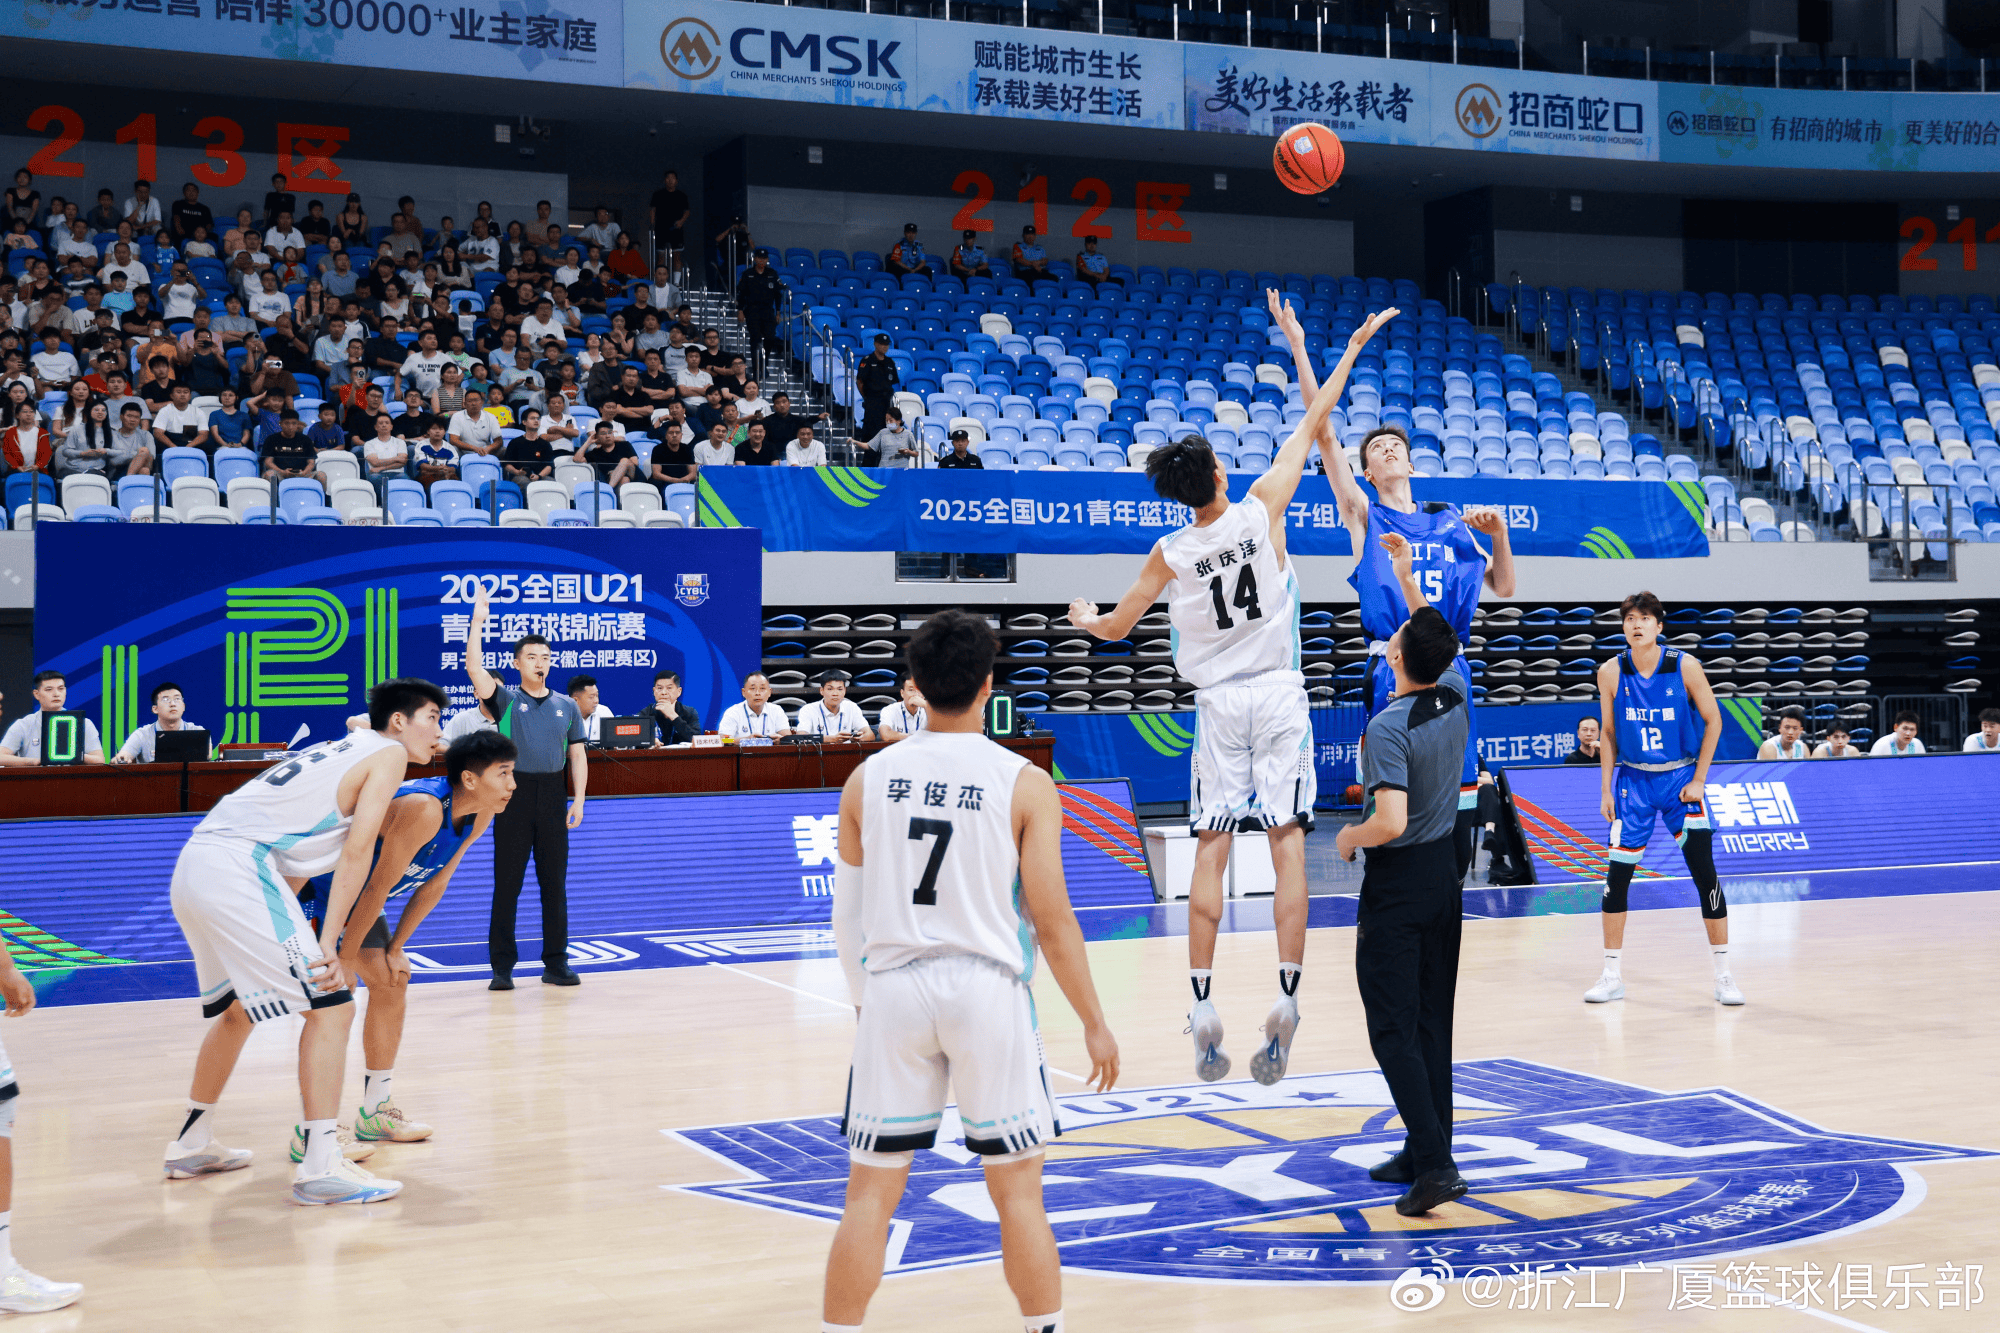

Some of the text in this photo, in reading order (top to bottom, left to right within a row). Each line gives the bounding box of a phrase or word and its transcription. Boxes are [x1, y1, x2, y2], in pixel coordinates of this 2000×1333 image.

[729, 27, 902, 79] CMSK
[974, 40, 1142, 81] 赋能城市生长
[730, 70, 903, 92] CHINA MERCHANTS SHEKOU HOLDINGS
[974, 76, 1142, 119] 承载美好生活
[1204, 65, 1414, 123] 美好生活承载者
[1508, 91, 1643, 134] 招商蛇口
[1692, 113, 1756, 132] 招商蛇口
[1770, 115, 2000, 146] 有招商的城市 更美好的合
[26, 104, 351, 195] 213区
[1508, 129, 1644, 146] CHINA MERCHANTS SHEKOU HOLDINGS
[951, 170, 1192, 243] 212区
[1194, 538, 1257, 578] 张庆泽
[1388, 542, 1456, 563] 江广厦
[440, 573, 643, 604] 2025全国U21
[680, 587, 706, 595] CYBL
[1209, 562, 1263, 630] 14
[1412, 569, 1443, 602] 15
[440, 611, 647, 644] 青年篮球锦标赛
[993, 696, 1013, 735] 0
[1625, 707, 1676, 722] 浙江广厦
[48, 715, 77, 761] 0
[1640, 727, 1664, 752] 12
[888, 778, 985, 811] 李俊杰
[1704, 781, 1801, 827] 美凯
[792, 814, 840, 867] 美
[1721, 831, 1811, 854] MERRY
[908, 816, 954, 906] 7
[1061, 1089, 1249, 1116] U21
